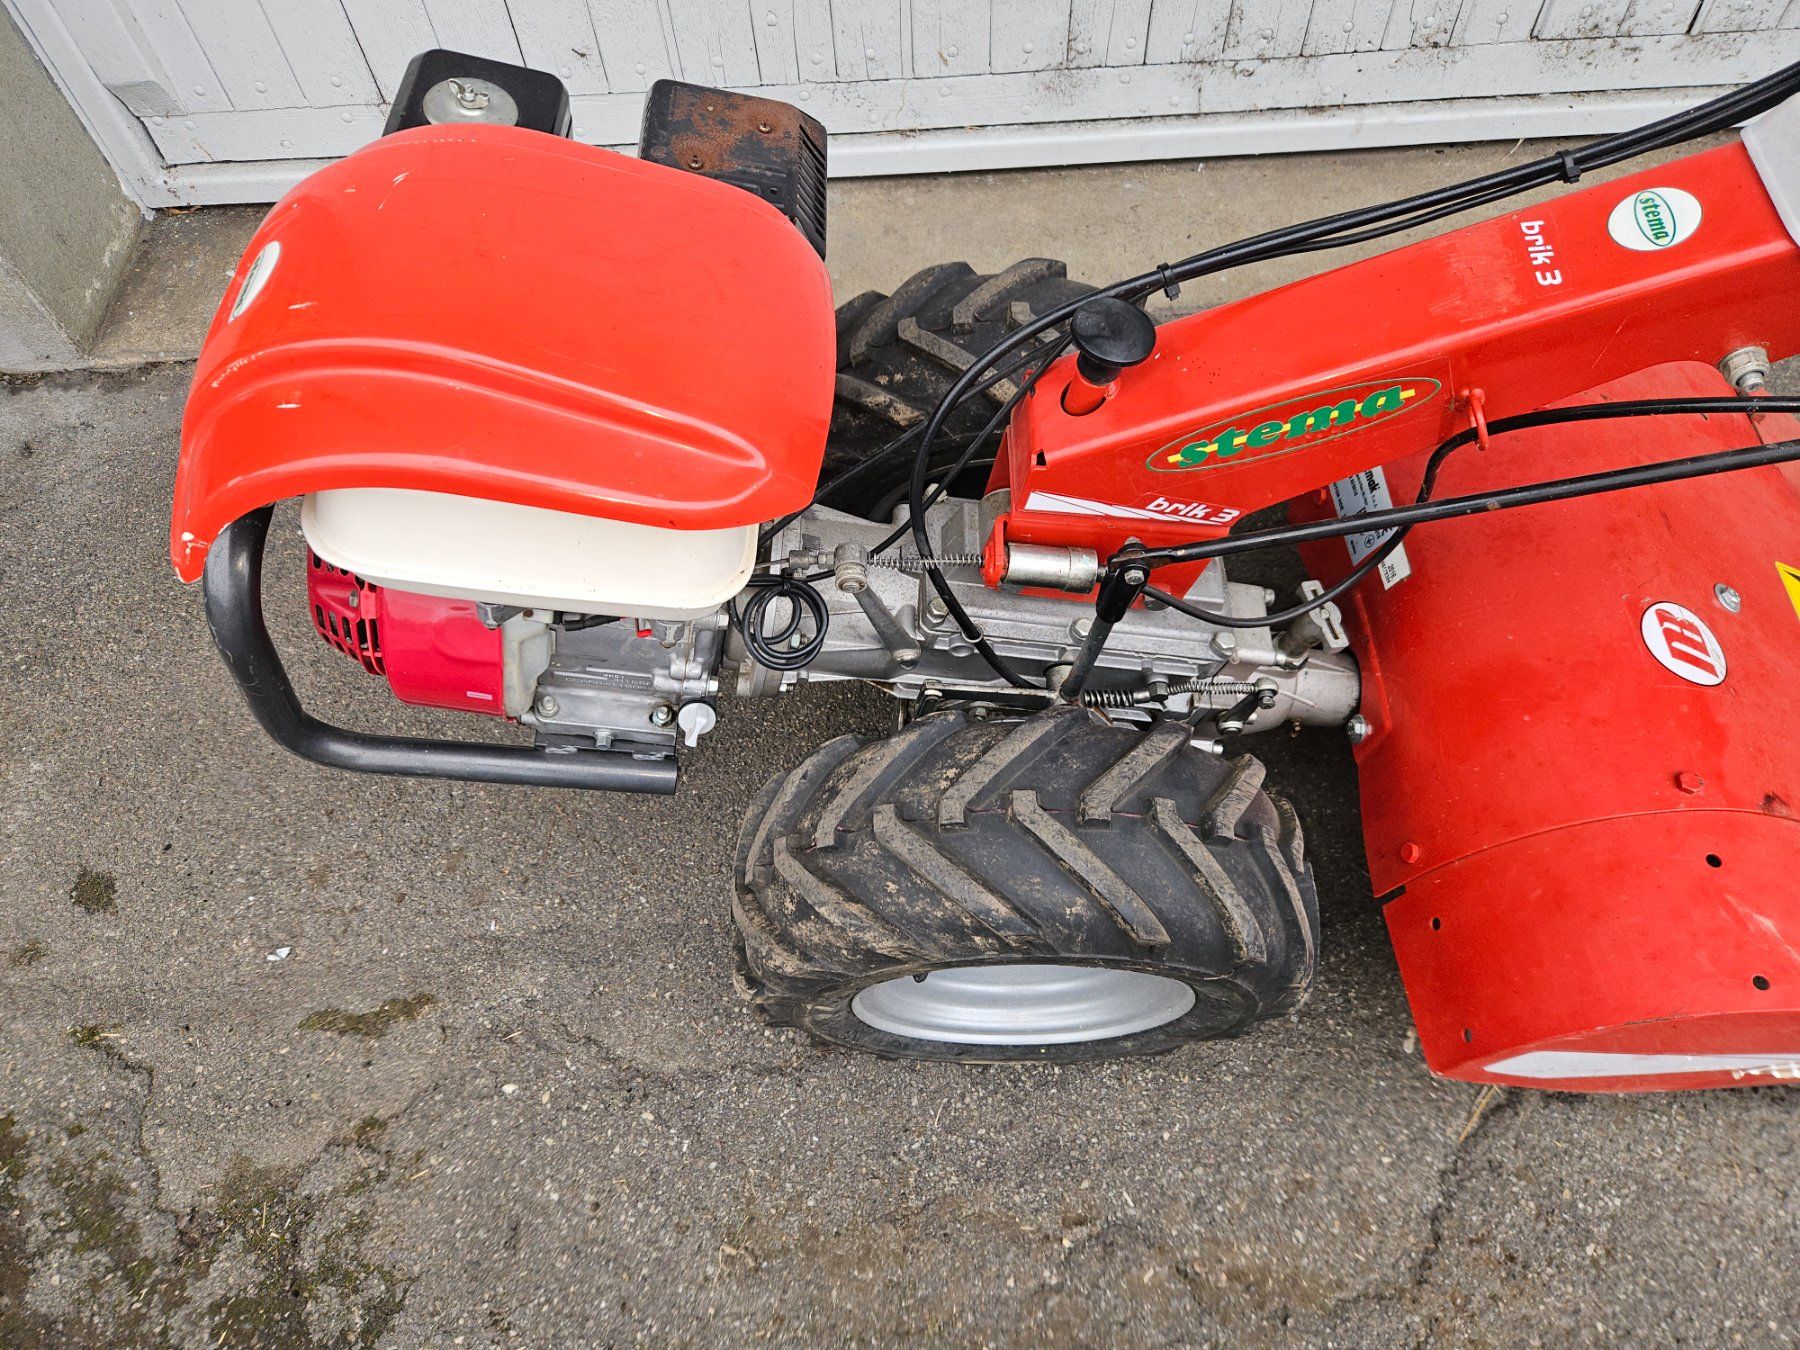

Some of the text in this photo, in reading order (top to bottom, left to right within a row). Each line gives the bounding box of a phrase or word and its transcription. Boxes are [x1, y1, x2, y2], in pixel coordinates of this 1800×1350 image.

[1639, 197, 1669, 240] stema
[1520, 220, 1562, 286] brik 3
[1178, 386, 1405, 468] stema
[1145, 497, 1240, 522] brik 3
